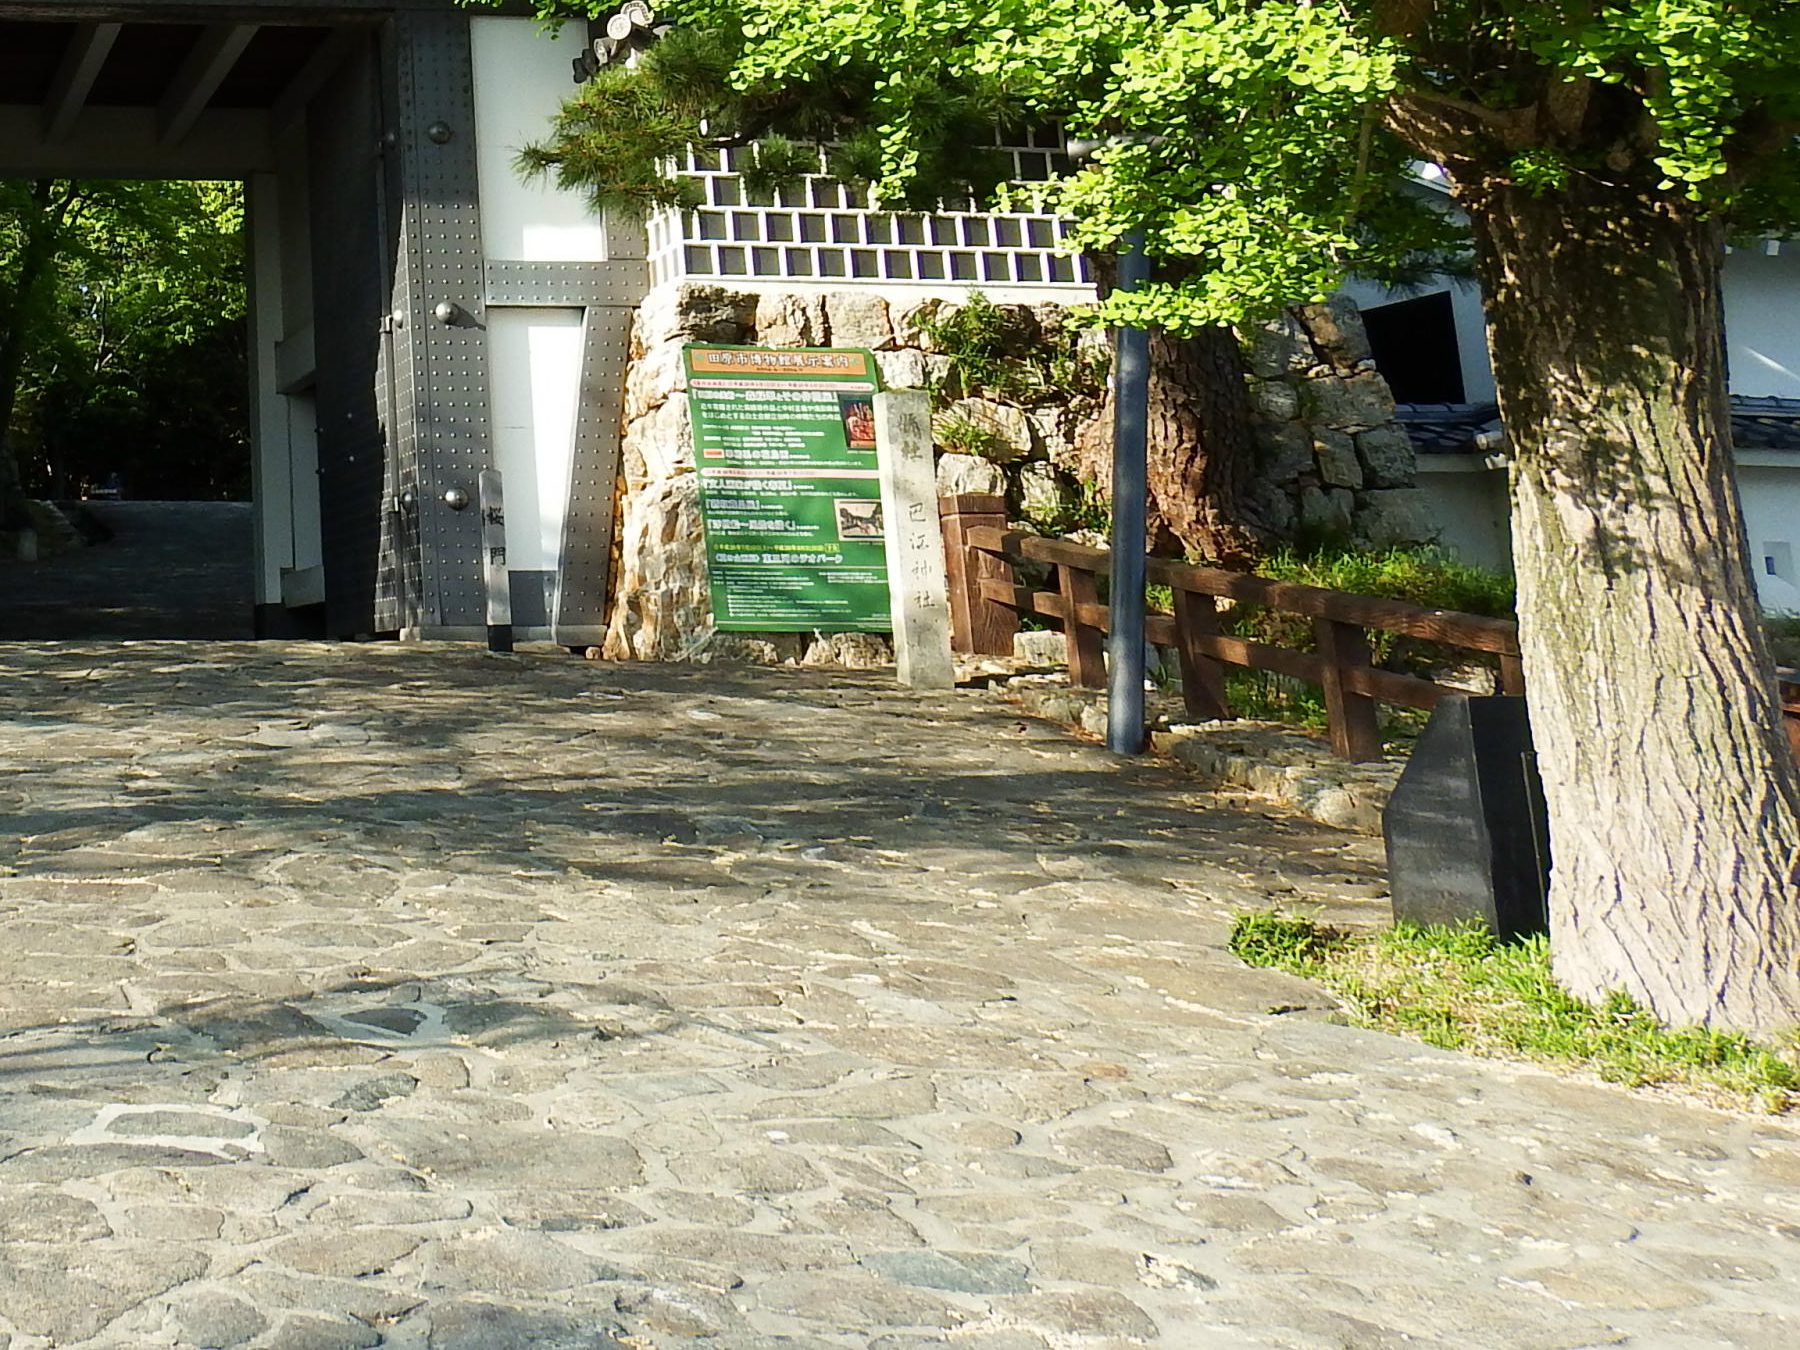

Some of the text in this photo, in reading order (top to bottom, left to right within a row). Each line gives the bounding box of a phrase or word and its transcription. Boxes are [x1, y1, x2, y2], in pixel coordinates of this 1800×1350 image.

[708, 352, 849, 368] 田原市博物館展示案内
[487, 506, 506, 565] 桜門
